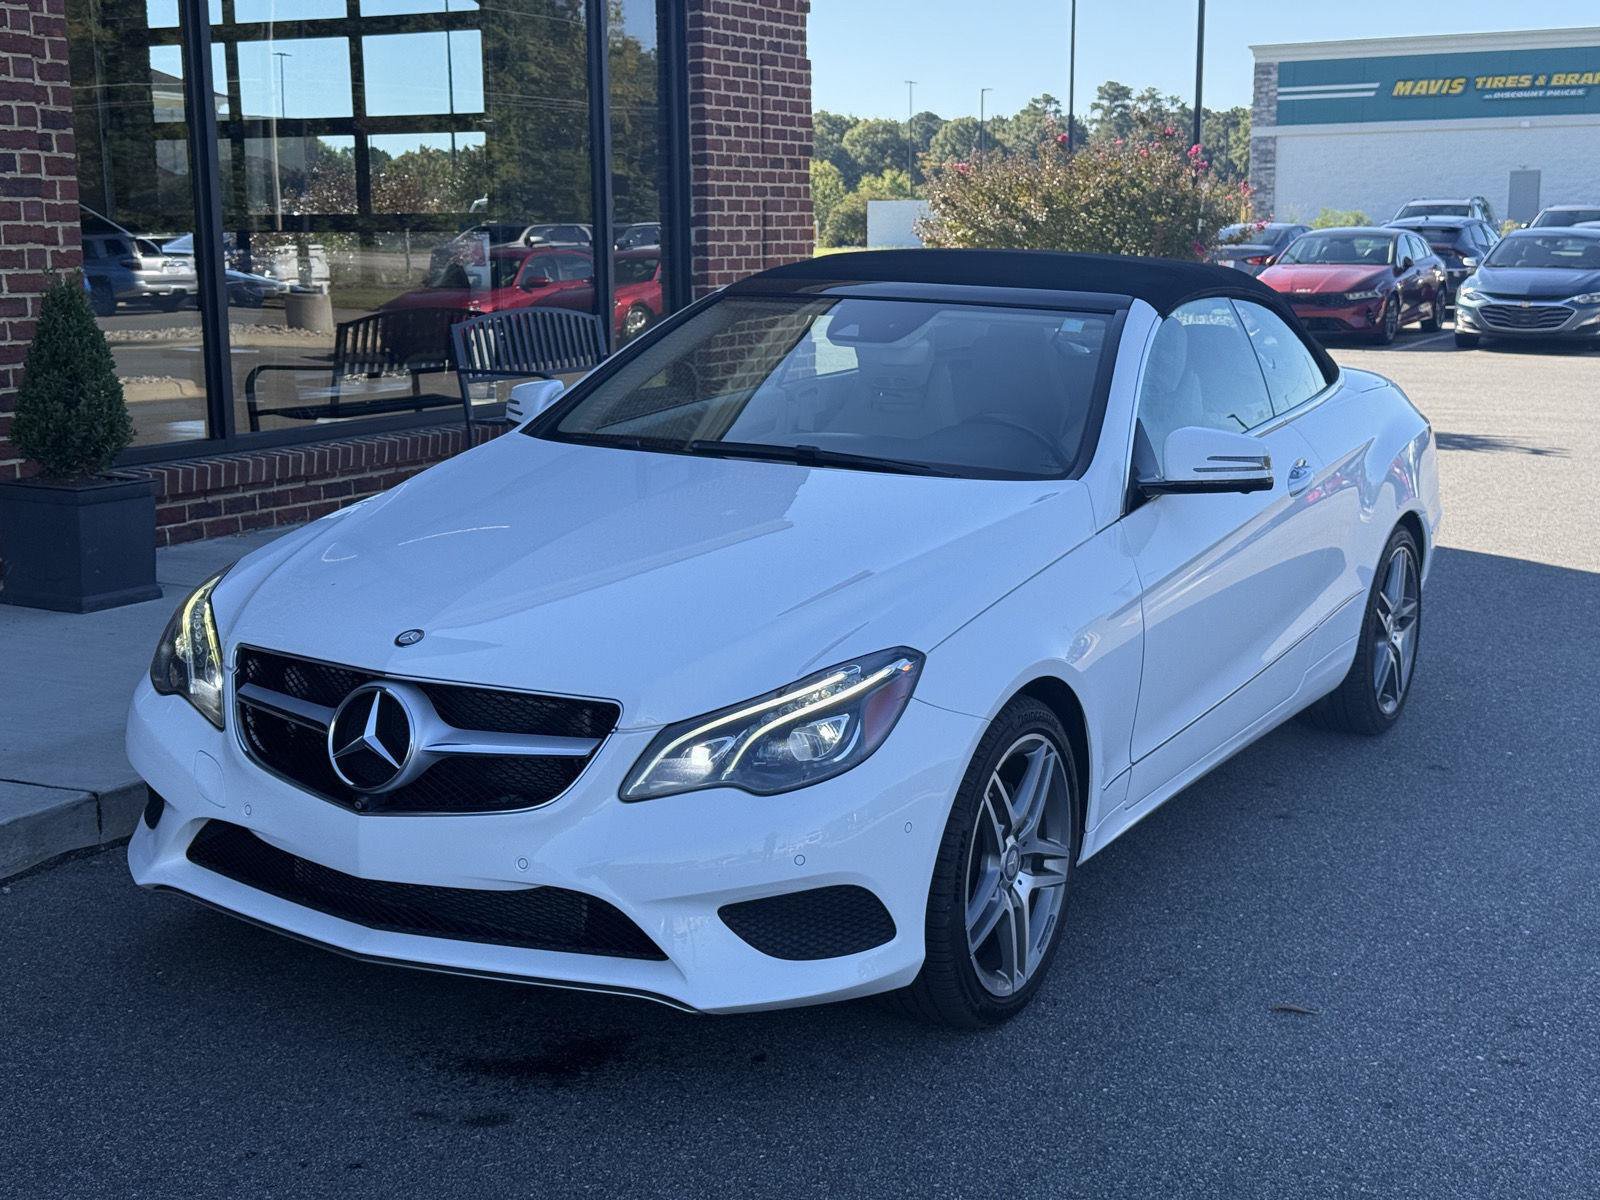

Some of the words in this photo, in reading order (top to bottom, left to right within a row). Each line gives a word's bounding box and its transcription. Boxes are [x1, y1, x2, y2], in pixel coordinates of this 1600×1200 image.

[1391, 78, 1467, 97] MAVIS
[1475, 75, 1533, 89] TIRES
[1535, 74, 1547, 86] &
